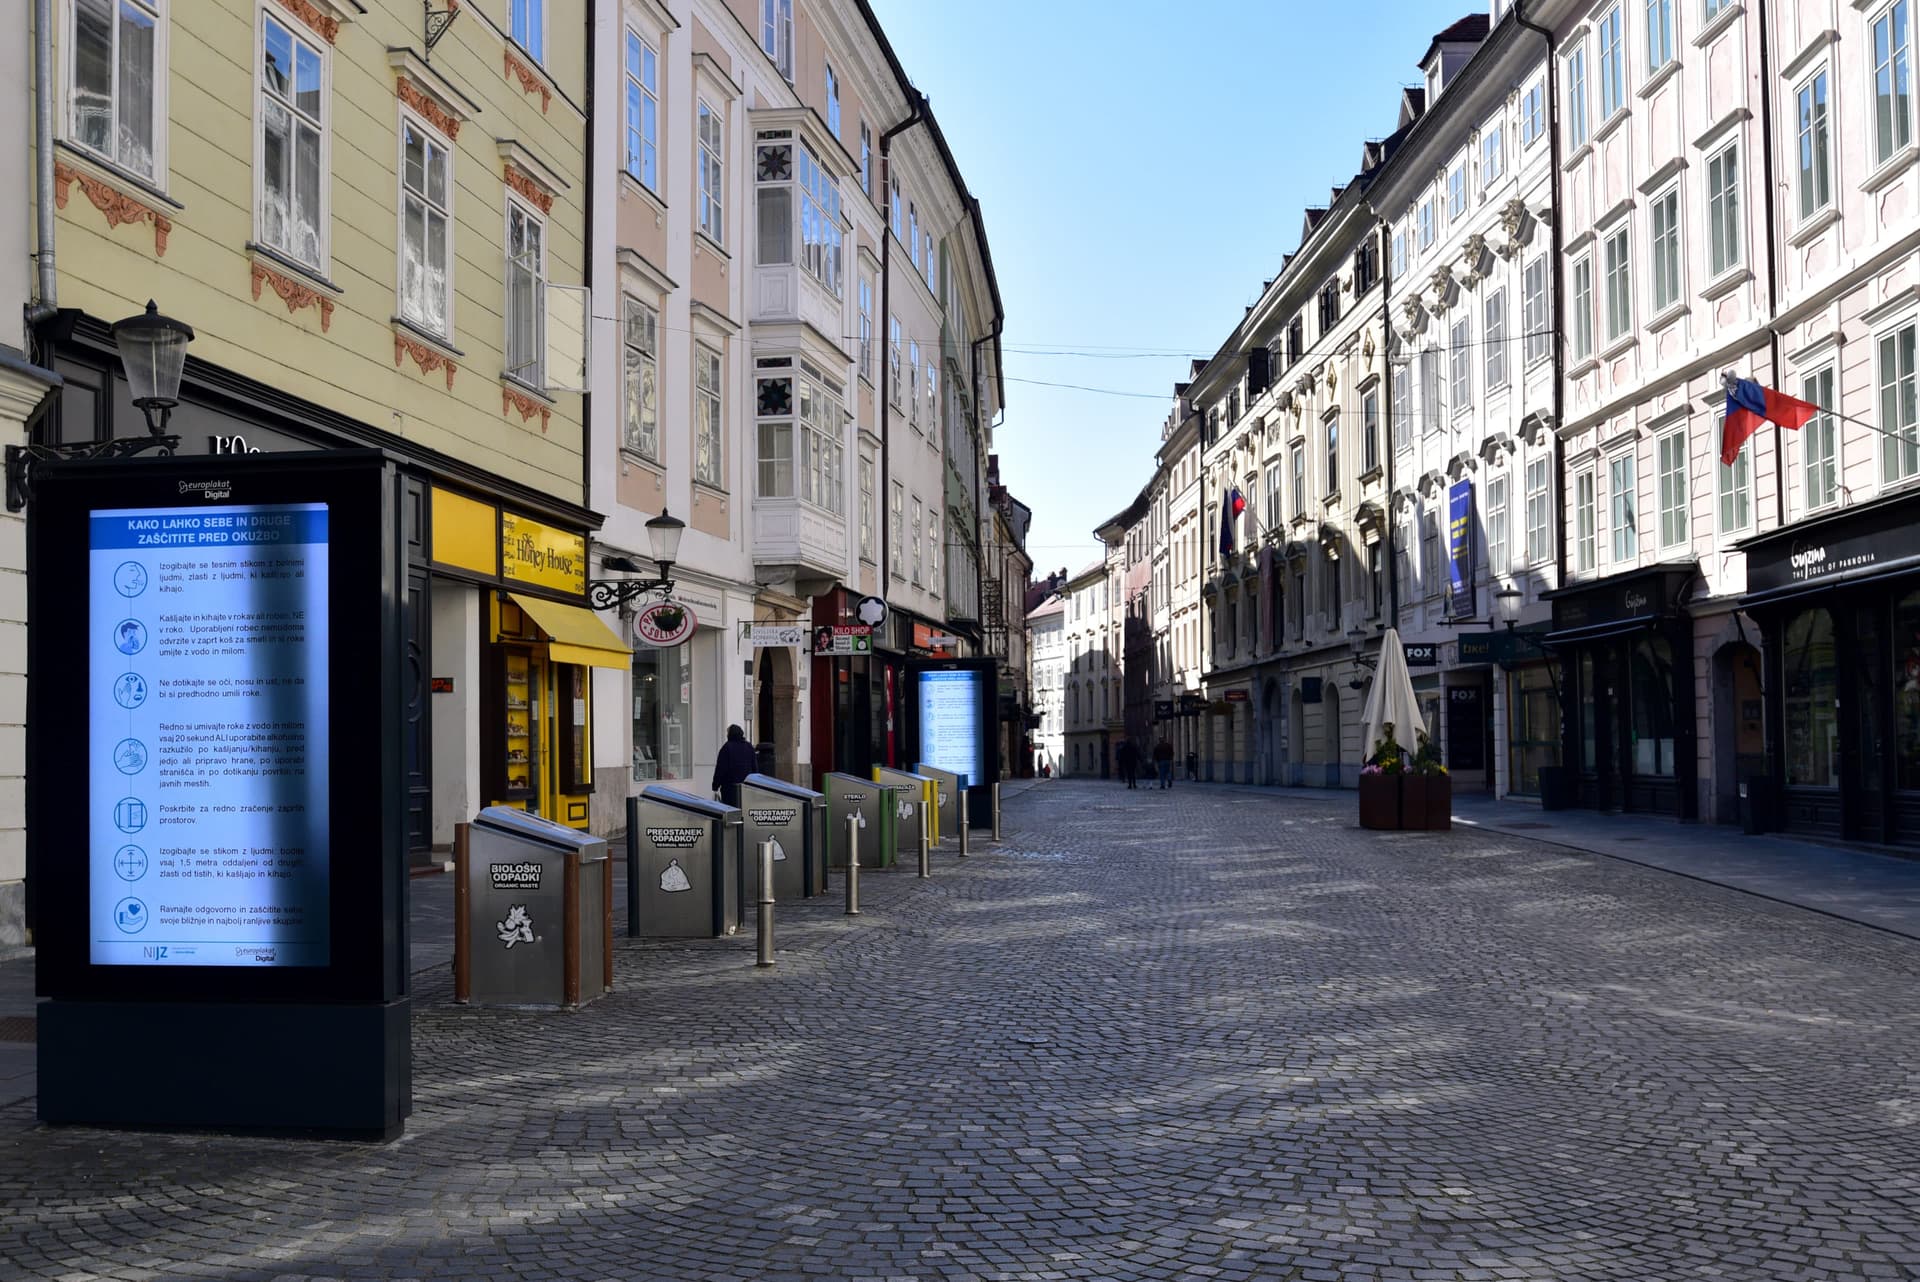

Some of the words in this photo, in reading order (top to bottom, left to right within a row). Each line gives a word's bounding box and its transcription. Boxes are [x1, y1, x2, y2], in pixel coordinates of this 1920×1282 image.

[205, 491, 230, 500] Digital
[128, 520, 159, 530] KAKO
[162, 518, 200, 529] LAHKO
[203, 518, 233, 528] SEBE
[236, 517, 248, 527] IN
[251, 516, 291, 526] DRUGE
[138, 530, 196, 544] ZAŠČITITE
[198, 531, 228, 542] PRED
[232, 529, 280, 542] OKUŽBO
[517, 538, 545, 573] Honey
[547, 547, 573, 575] House
[160, 562, 196, 571] Izogibajte
[240, 560, 265, 568] stikom
[1792, 569, 1804, 580] THE
[1808, 565, 1825, 576] SOUL
[1827, 561, 1836, 571] OF
[1839, 553, 1875, 569] PANNONIA
[160, 585, 184, 593] kihajo.
[160, 613, 191, 623] Kašljajte
[202, 612, 226, 622] kihajte
[293, 611, 304, 619] NE
[190, 625, 233, 634] Uporabljeni
[835, 626, 850, 634] KILO
[851, 625, 870, 634] SHOP
[160, 636, 188, 645] odvrzite
[198, 637, 217, 645] zaprt
[160, 648, 182, 656] umijte
[221, 647, 246, 655] milom.
[1407, 648, 1432, 657] FOX
[172, 679, 205, 688] dotikajte
[178, 690, 220, 699] predhodno
[1451, 690, 1476, 700] FOX
[160, 723, 184, 731] Redno
[194, 723, 225, 732] umivajte
[160, 735, 174, 743] vsaj
[229, 734, 265, 743] uporabite
[160, 758, 178, 766] jedjo
[160, 768, 194, 776] stranišča
[198, 768, 205, 776] in
[223, 768, 258, 776] dotikanju
[160, 780, 182, 788] javnih
[184, 780, 212, 788] mestih.
[160, 805, 195, 813] Poskrbite
[213, 805, 236, 813] redno
[240, 804, 273, 814] zračenje
[647, 828, 702, 836] PREOSTANEK
[160, 848, 196, 857] Izogibajte
[160, 859, 175, 868] vsaj
[180, 859, 191, 867] 1,5
[222, 859, 258, 868] oddaljeni
[263, 859, 273, 867] od
[491, 863, 541, 873] BIOLOŠKI
[181, 870, 192, 878] od
[226, 870, 255, 879] kašljajo
[493, 873, 539, 881] ODPADKI
[160, 906, 192, 915] Ravnajte
[195, 906, 236, 915] odgovorno
[160, 917, 179, 926] svoje
[181, 916, 206, 926] bližnje
[208, 917, 214, 925] in
[216, 916, 242, 927] najbolj
[243, 917, 271, 926] ranljive
[144, 946, 168, 960] NIJZ
